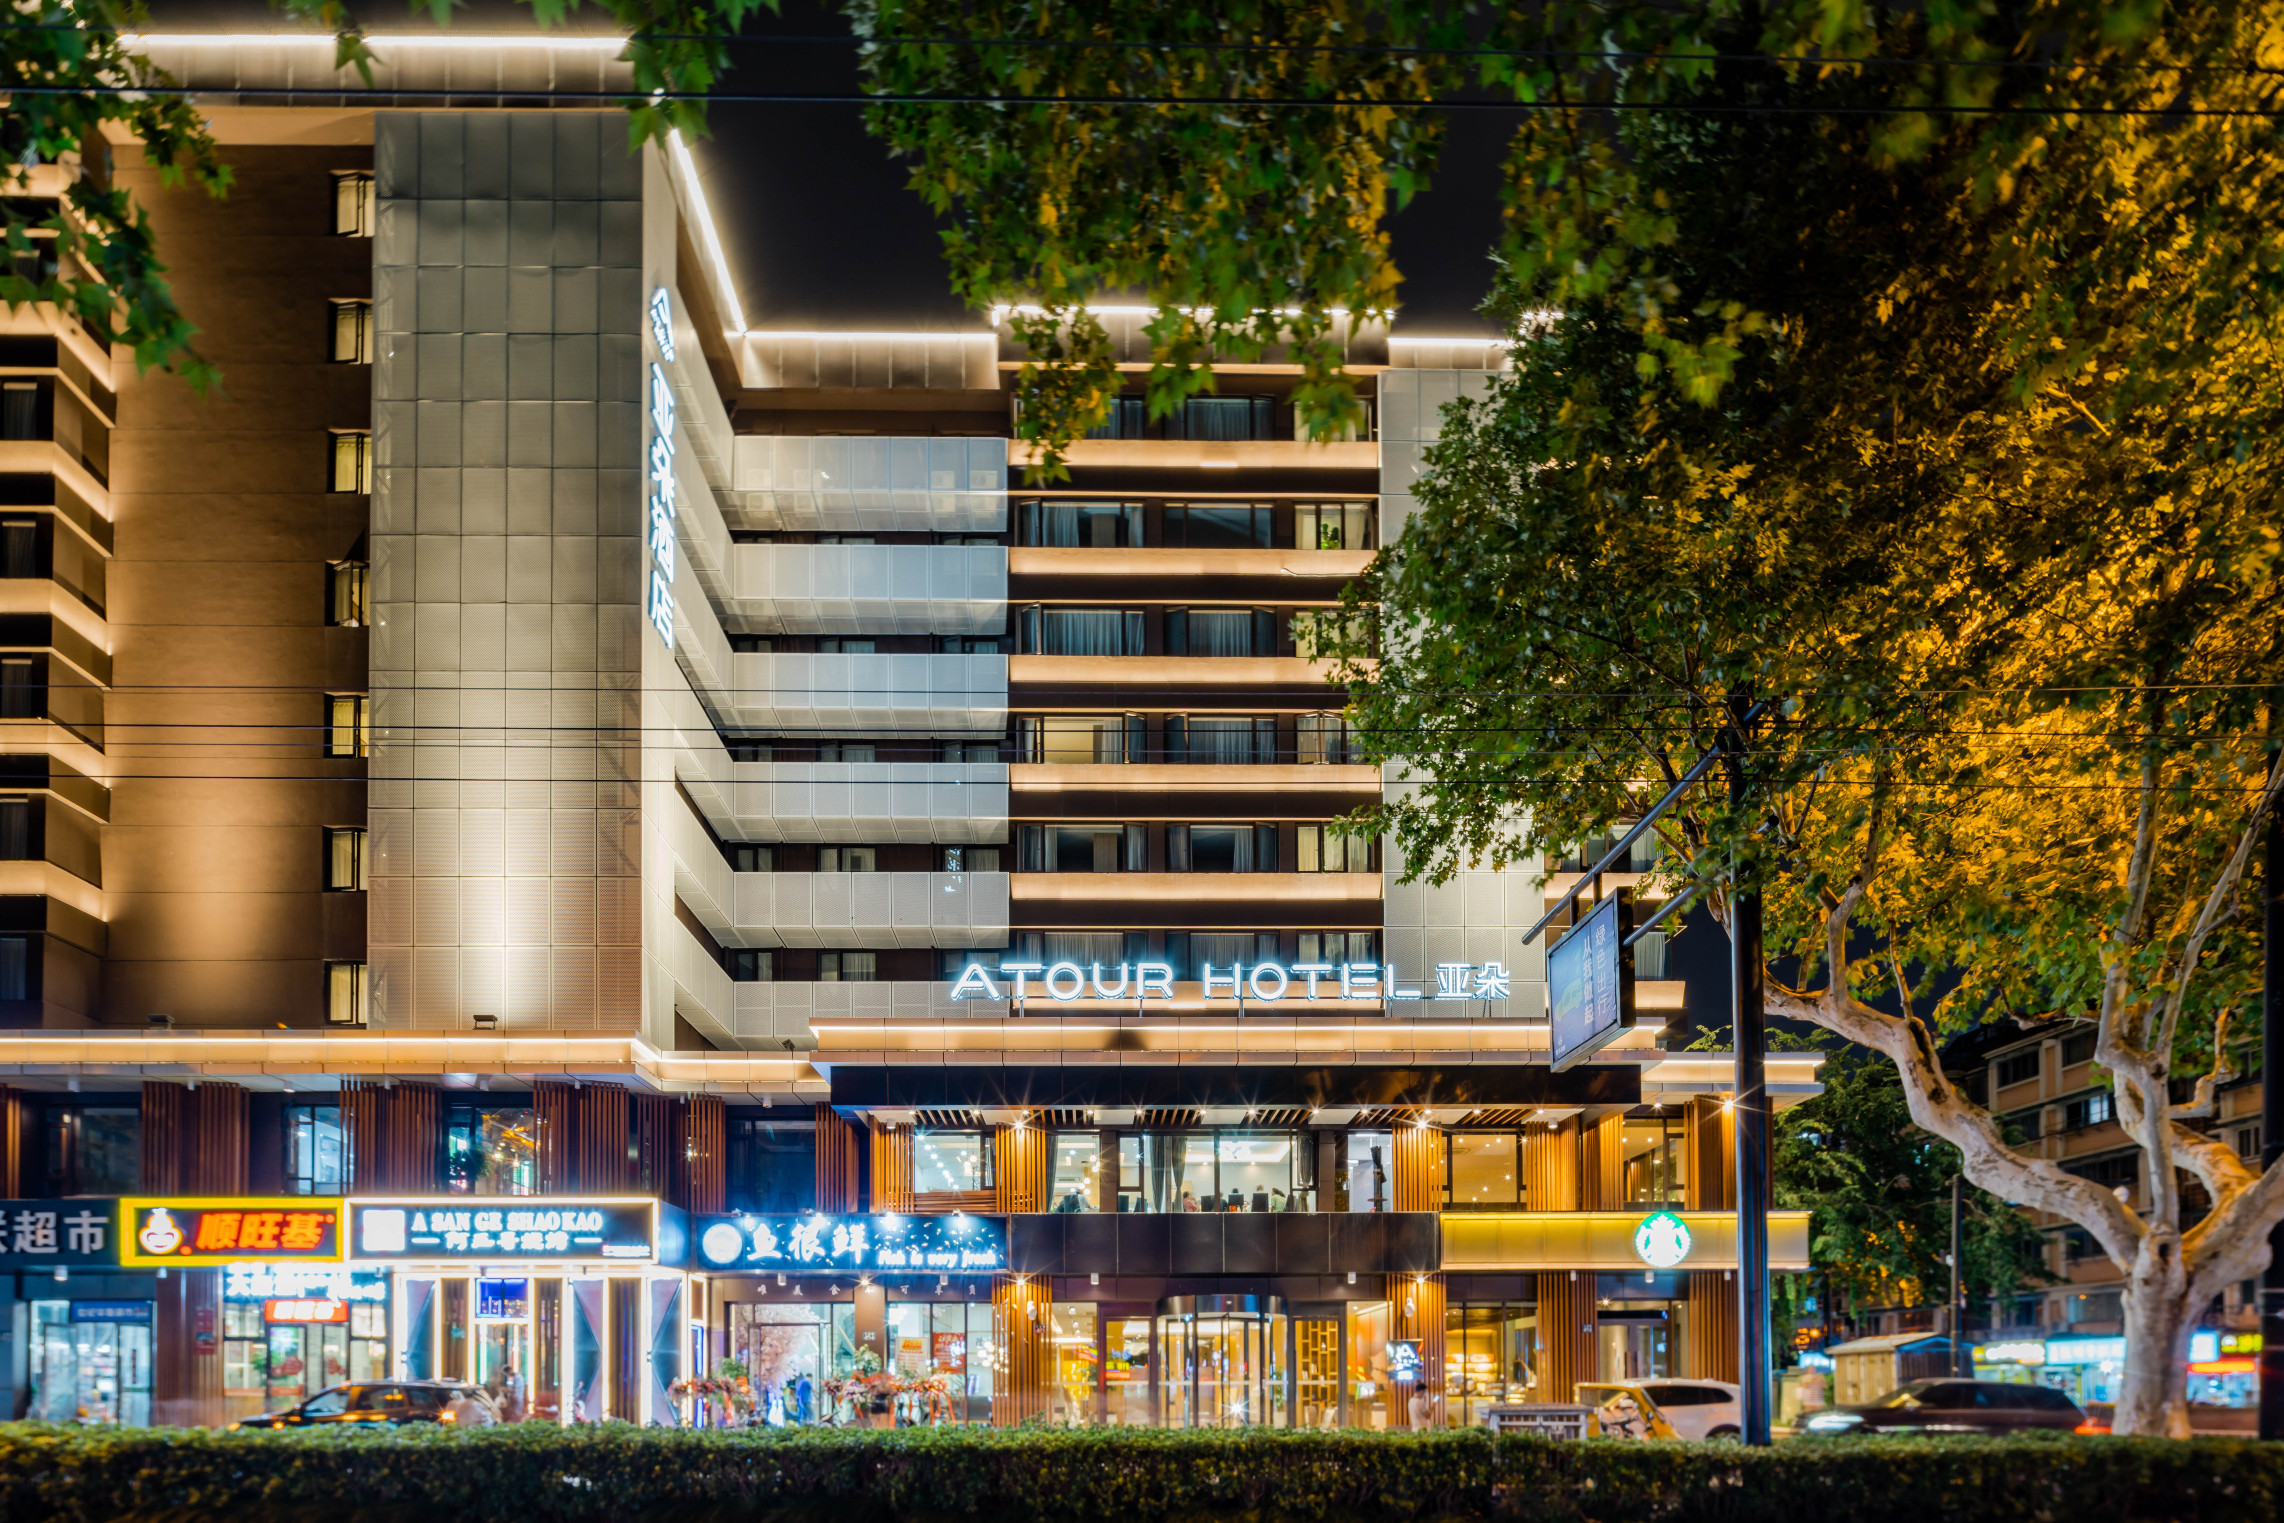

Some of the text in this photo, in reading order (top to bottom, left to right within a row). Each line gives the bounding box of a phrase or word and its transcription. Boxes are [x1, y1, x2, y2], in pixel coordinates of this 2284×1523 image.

[650, 362, 676, 650] 亚朵酒店
[950, 961, 1512, 1001] ATOUR HOTEL 亚朵
[1583, 935, 1595, 1026] 从我做起
[1595, 924, 1607, 1016] 绿色出行
[0, 1211, 109, 1254] 超市
[195, 1213, 325, 1250] 顺旺基
[411, 1212, 428, 1231] A
[431, 1212, 471, 1231] SAN
[474, 1212, 503, 1231] GE
[747, 1223, 870, 1264] 鱼很鲜
